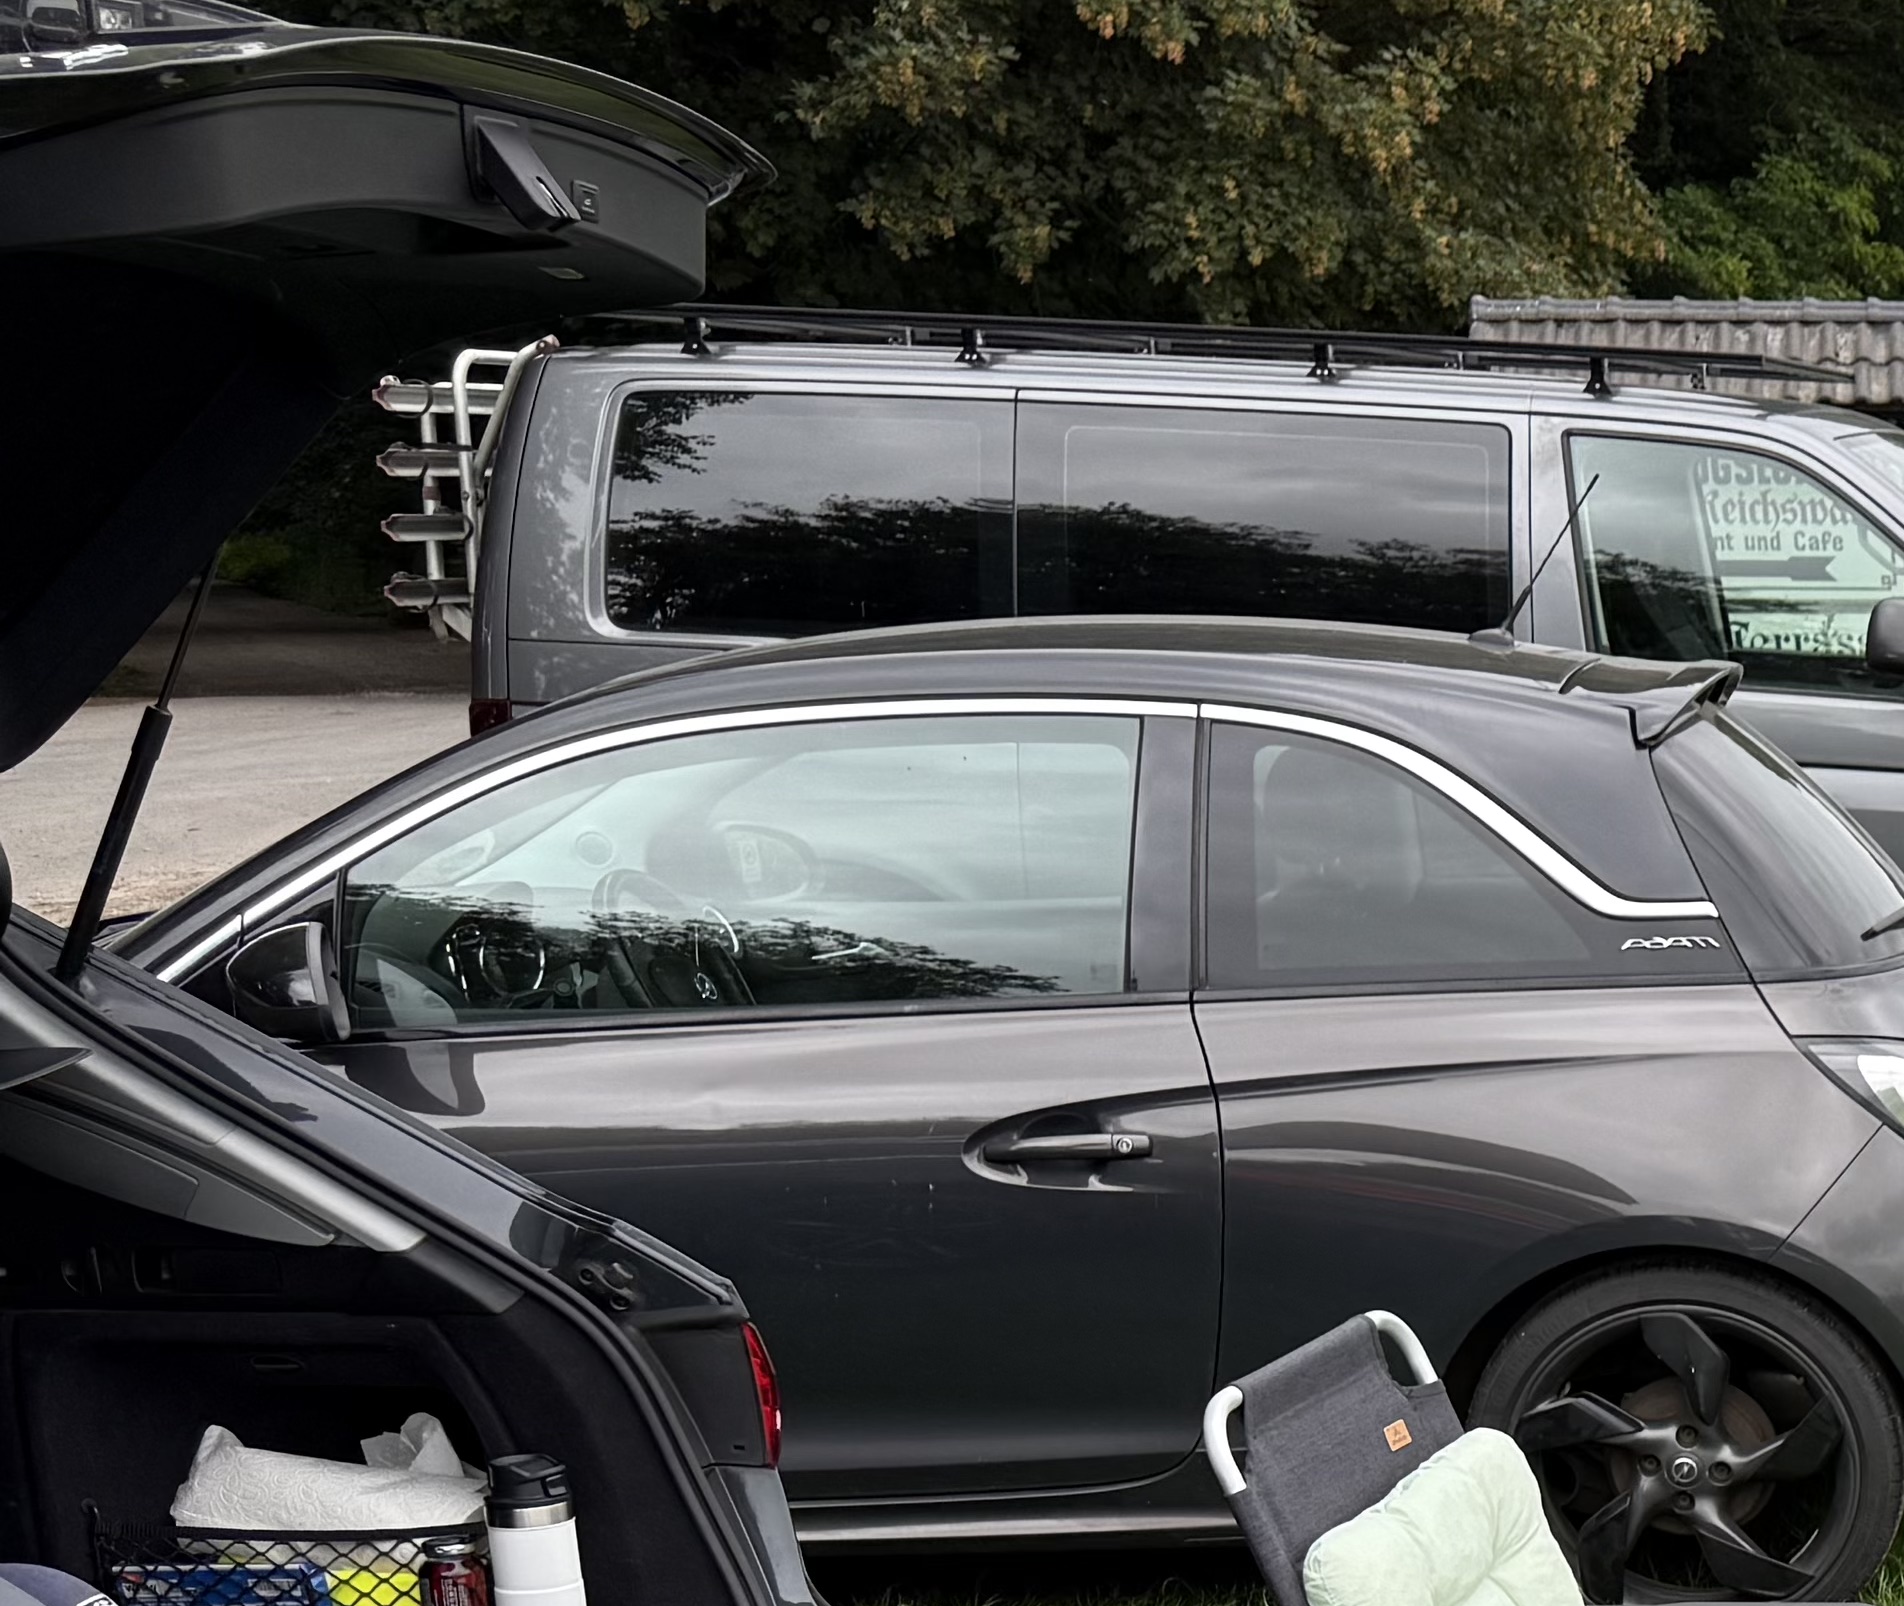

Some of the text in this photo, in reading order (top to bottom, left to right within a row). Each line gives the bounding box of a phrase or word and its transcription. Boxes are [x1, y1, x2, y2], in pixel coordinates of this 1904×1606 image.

[1705, 489, 1854, 532] Reichswa
[1745, 531, 1781, 551] und
[1794, 530, 1844, 551] Cafe
